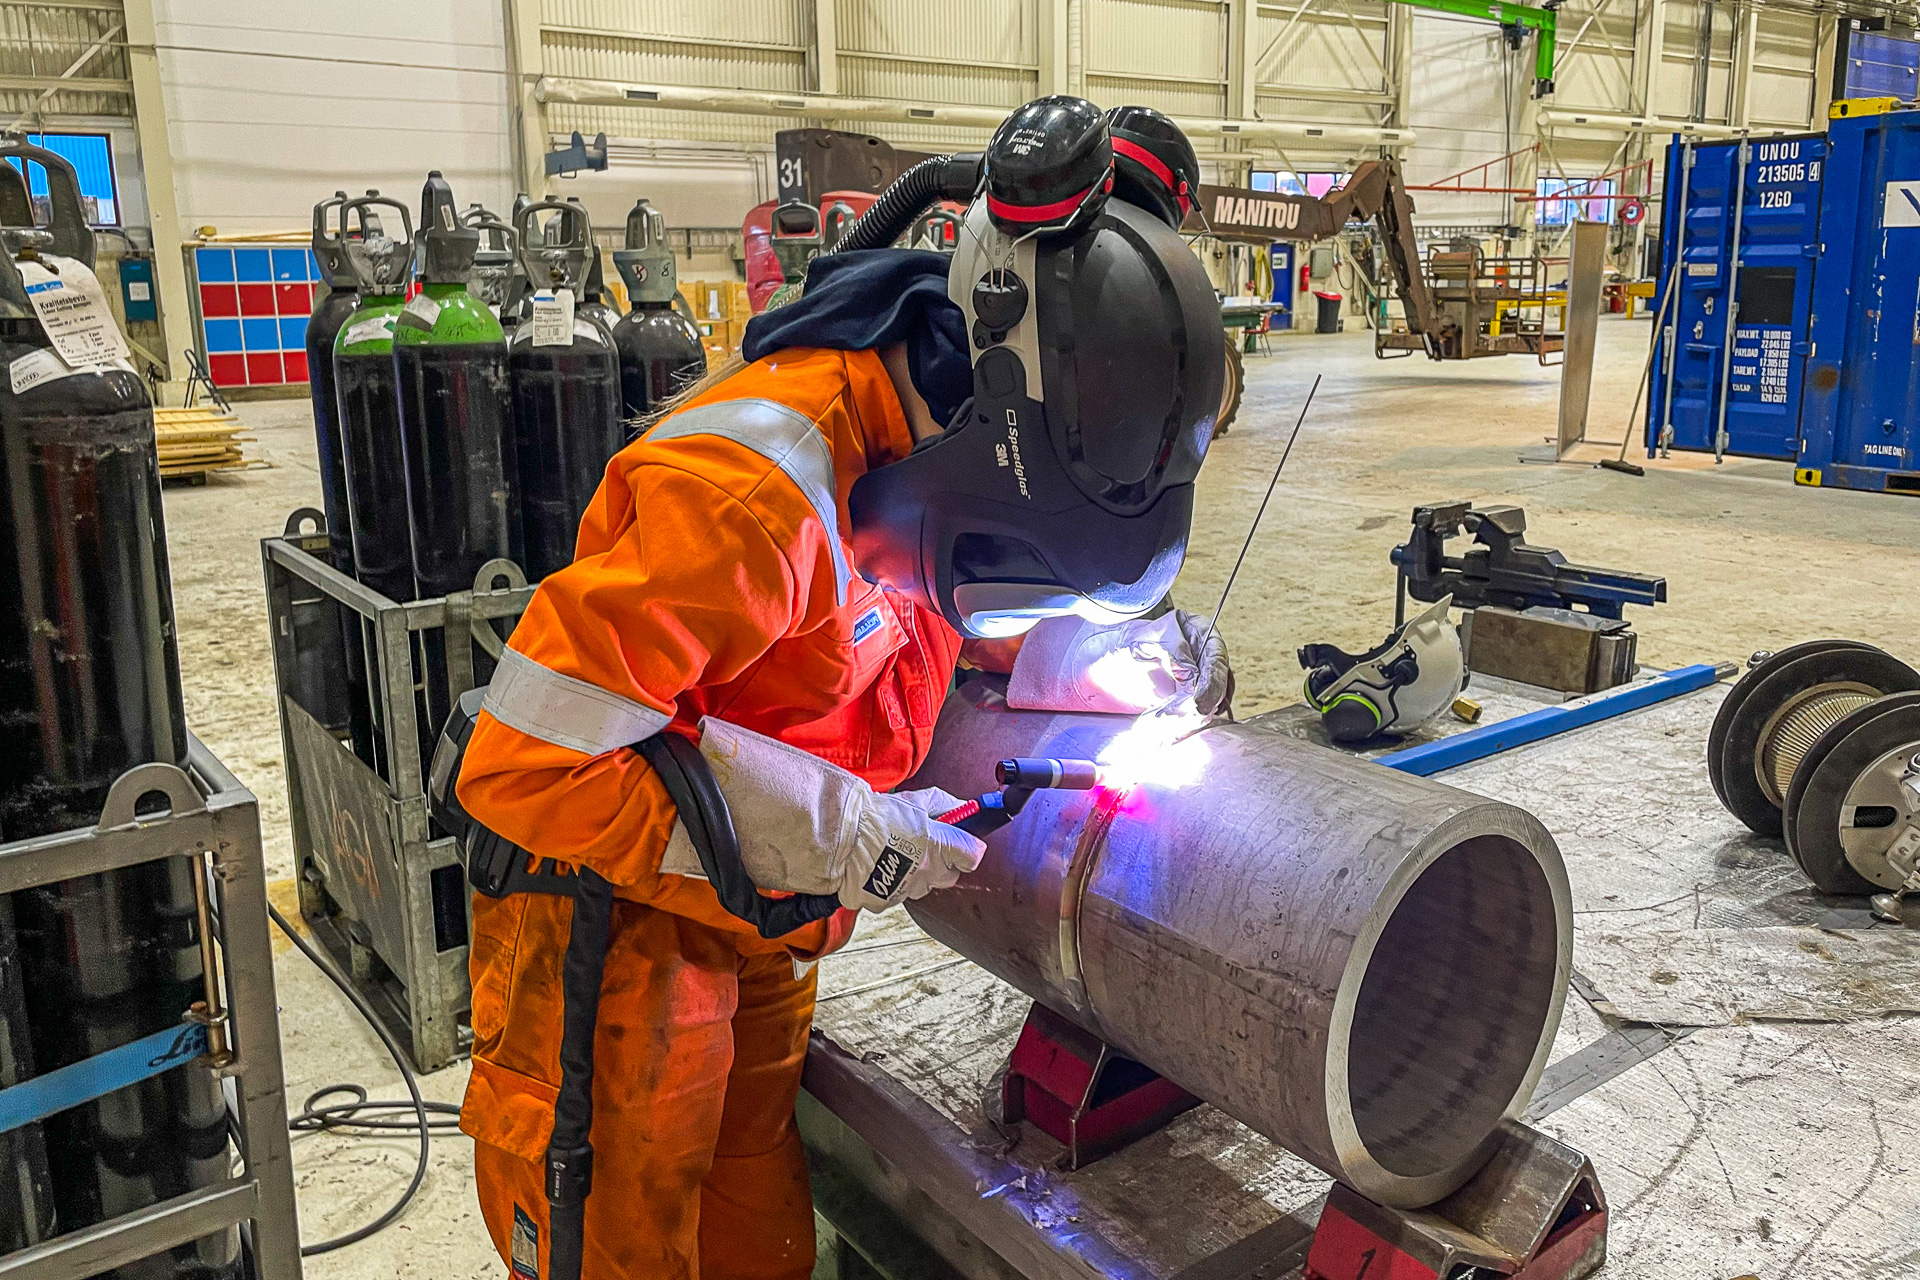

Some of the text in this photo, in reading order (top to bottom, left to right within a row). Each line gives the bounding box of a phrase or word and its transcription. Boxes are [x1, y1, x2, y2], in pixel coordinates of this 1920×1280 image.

[1760, 142, 1799, 161] UNOU
[780, 157, 803, 189] 31
[1758, 162, 1820, 183] 213505 4
[1213, 195, 1301, 230] MANITOU
[1734, 348, 1759, 357] PAYLOAD
[995, 443, 1009, 467] 3M
[1008, 427, 1028, 496] Speedglas
[1864, 444, 1877, 454] TAG
[1878, 445, 1892, 455] LINE
[872, 853, 900, 896] Odin
